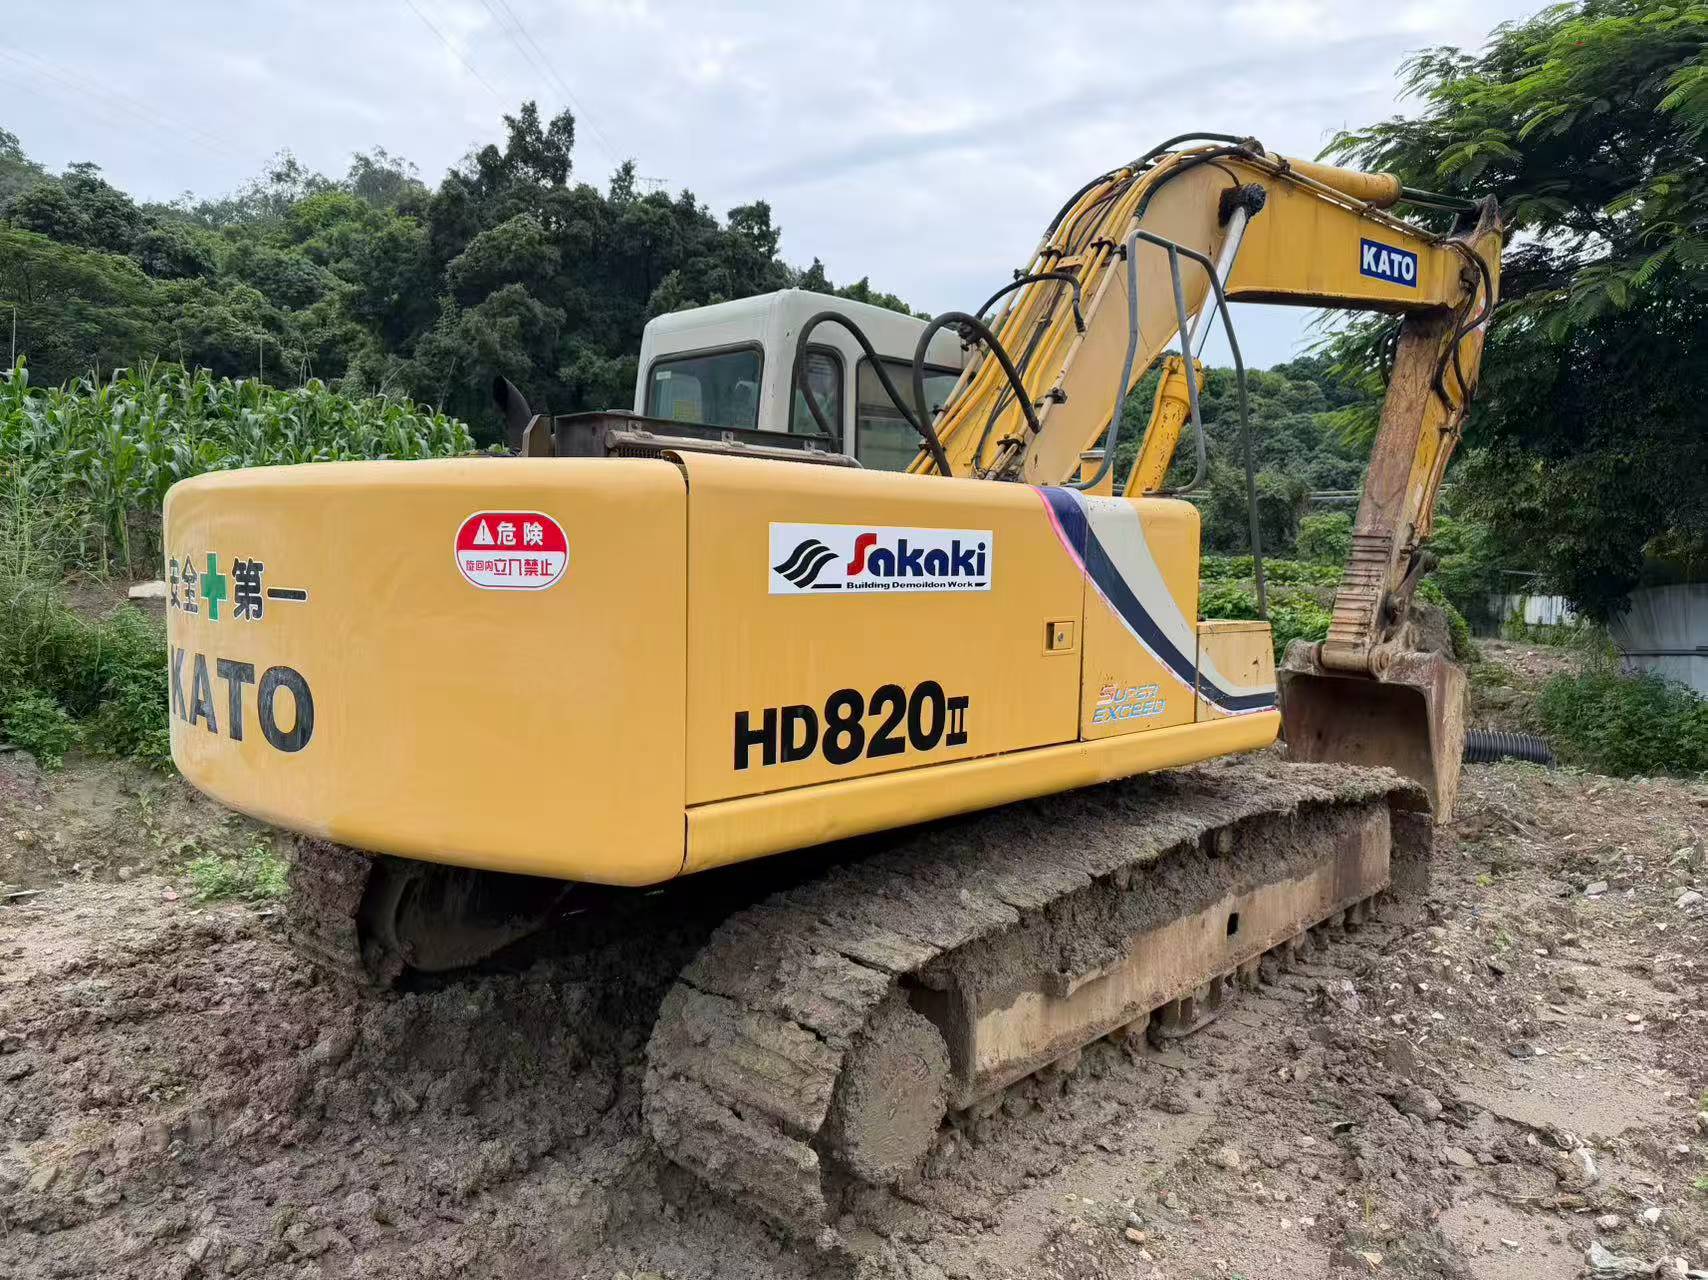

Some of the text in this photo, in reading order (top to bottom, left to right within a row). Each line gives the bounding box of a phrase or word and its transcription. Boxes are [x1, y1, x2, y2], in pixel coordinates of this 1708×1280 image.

[1363, 244, 1415, 281] KATO
[496, 521, 544, 546] 危険
[847, 533, 986, 577] Sakaki
[846, 581, 890, 591] Building
[171, 645, 315, 752] KATO
[1092, 701, 1167, 725] EXCEED
